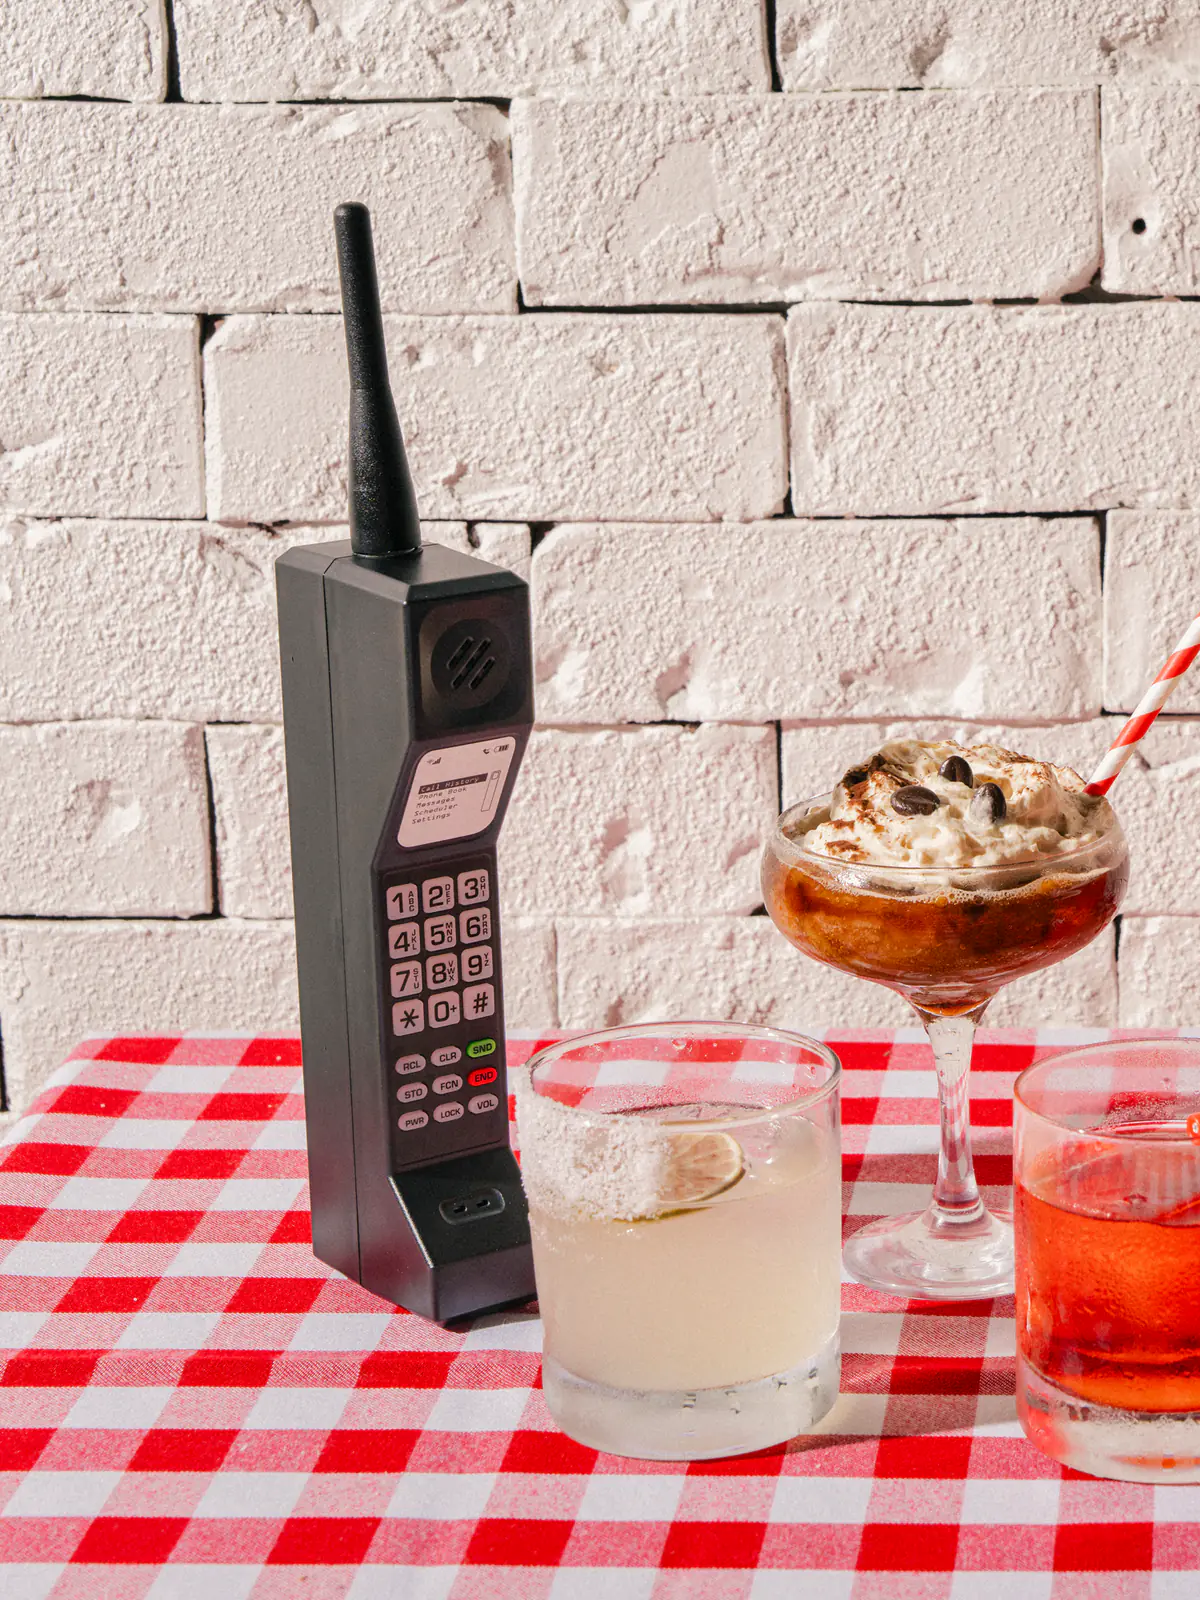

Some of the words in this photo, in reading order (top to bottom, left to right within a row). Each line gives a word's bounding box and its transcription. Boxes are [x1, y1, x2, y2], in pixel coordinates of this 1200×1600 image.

[421, 784, 440, 793] Call
[445, 777, 480, 788] History
[419, 790, 443, 800] Phone
[448, 787, 467, 795] Book
[416, 797, 455, 808] Messages
[414, 805, 458, 817] Scheduler
[412, 813, 451, 824] Settings
[464, 878, 479, 899] 3
[392, 892, 403, 913] 1
[429, 886, 443, 908] 2
[466, 916, 481, 938] 6
[430, 924, 445, 945] 5
[394, 931, 410, 952] 4
[468, 955, 482, 976] 9
[432, 962, 447, 984] 8
[396, 970, 410, 992] 7
[473, 1043, 492, 1054] SND
[439, 1052, 456, 1062] CLR
[403, 1061, 421, 1071] RCL
[475, 1072, 493, 1082] END
[440, 1080, 458, 1090] FCN
[404, 1089, 422, 1099] STO
[477, 1100, 494, 1110] VOL
[440, 1108, 460, 1119] LOCK
[405, 1117, 424, 1127] PWR
